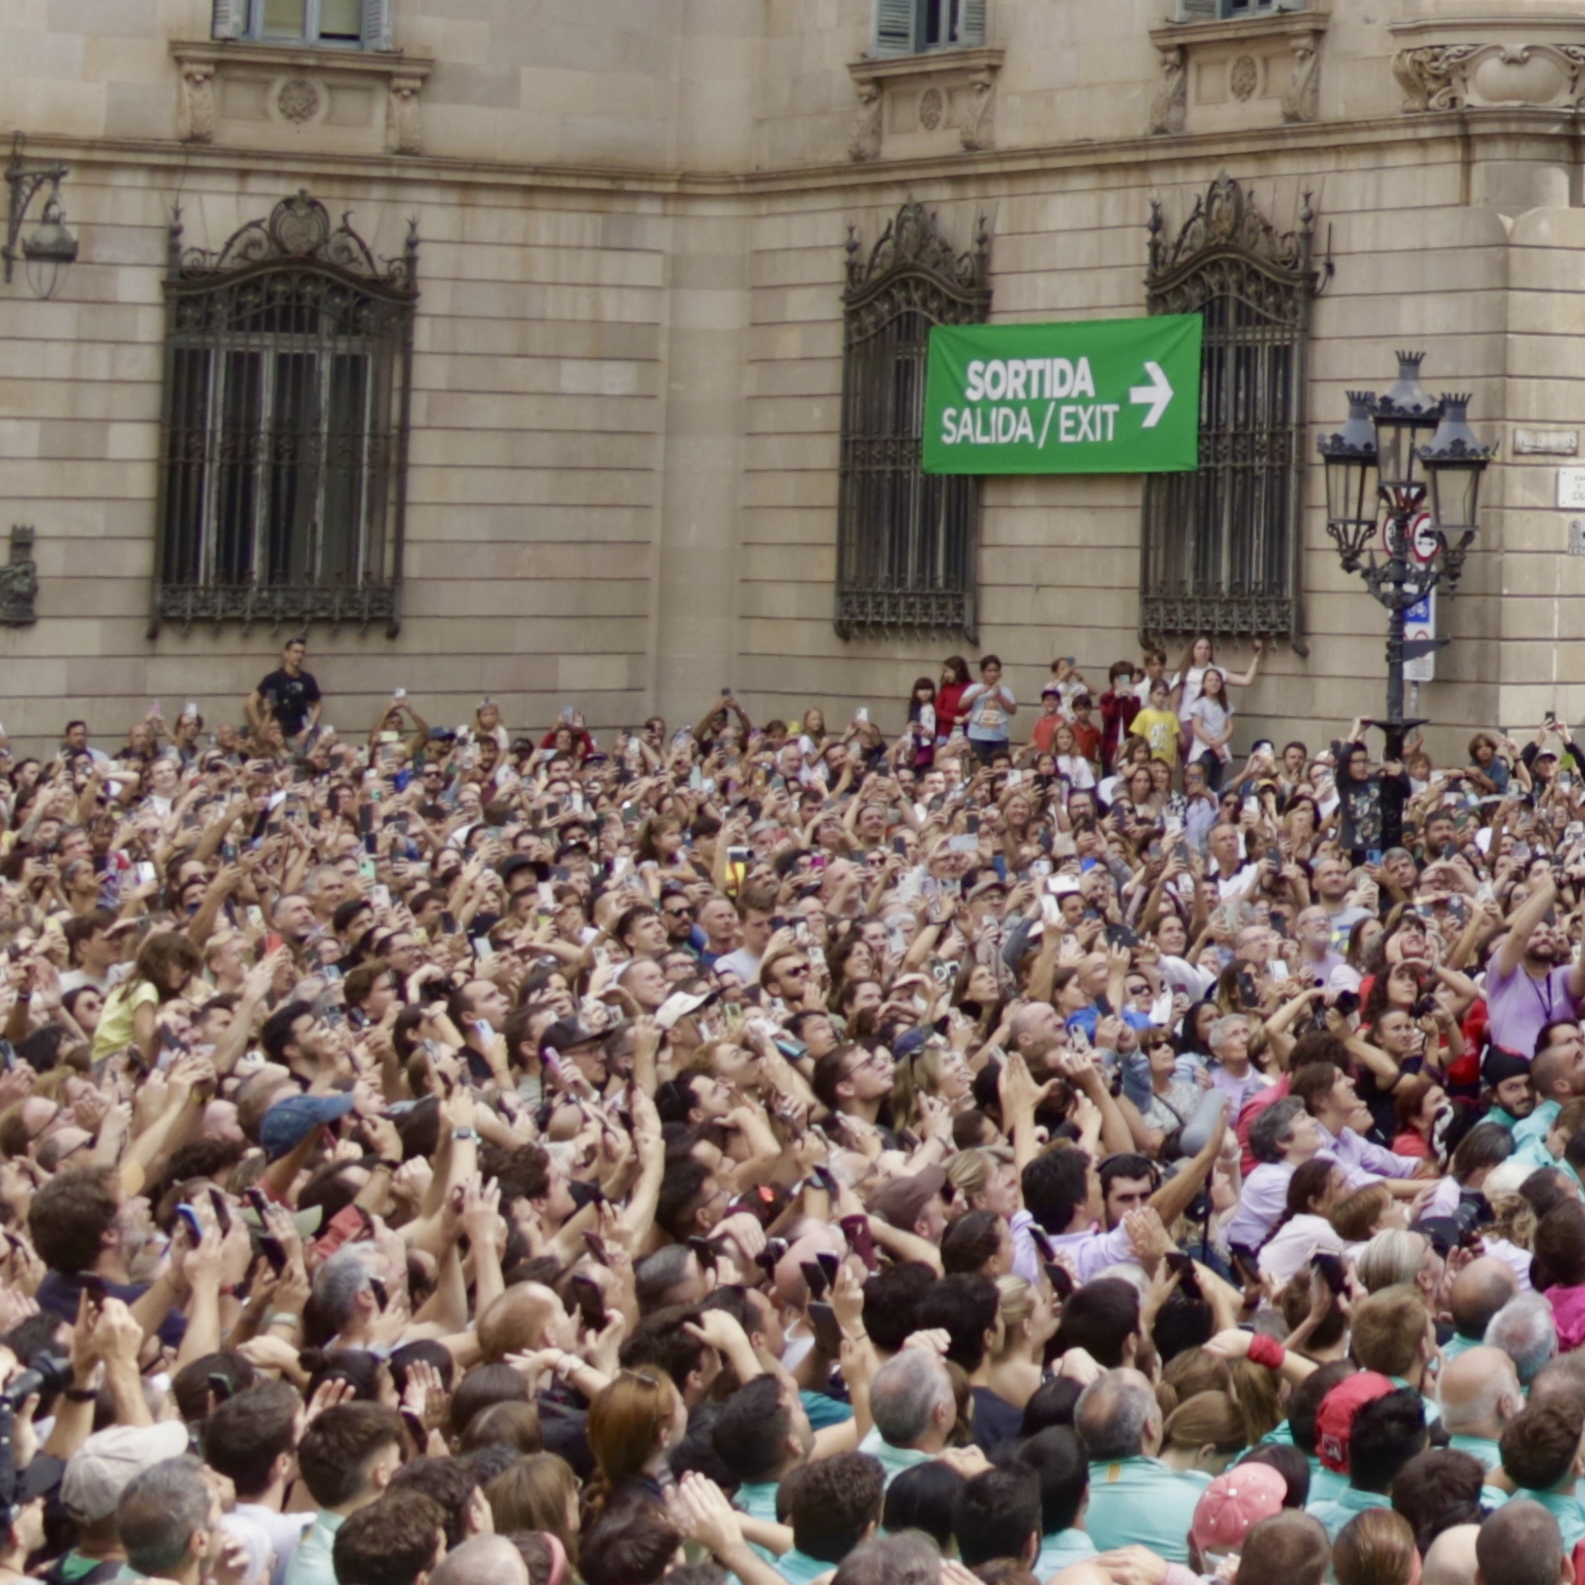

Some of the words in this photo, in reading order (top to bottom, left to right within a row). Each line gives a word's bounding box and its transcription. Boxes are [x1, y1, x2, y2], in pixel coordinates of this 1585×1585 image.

[965, 356, 1096, 401] SORTIDA
[941, 406, 1035, 444] SALIDA
[1059, 404, 1120, 443] EXIT
